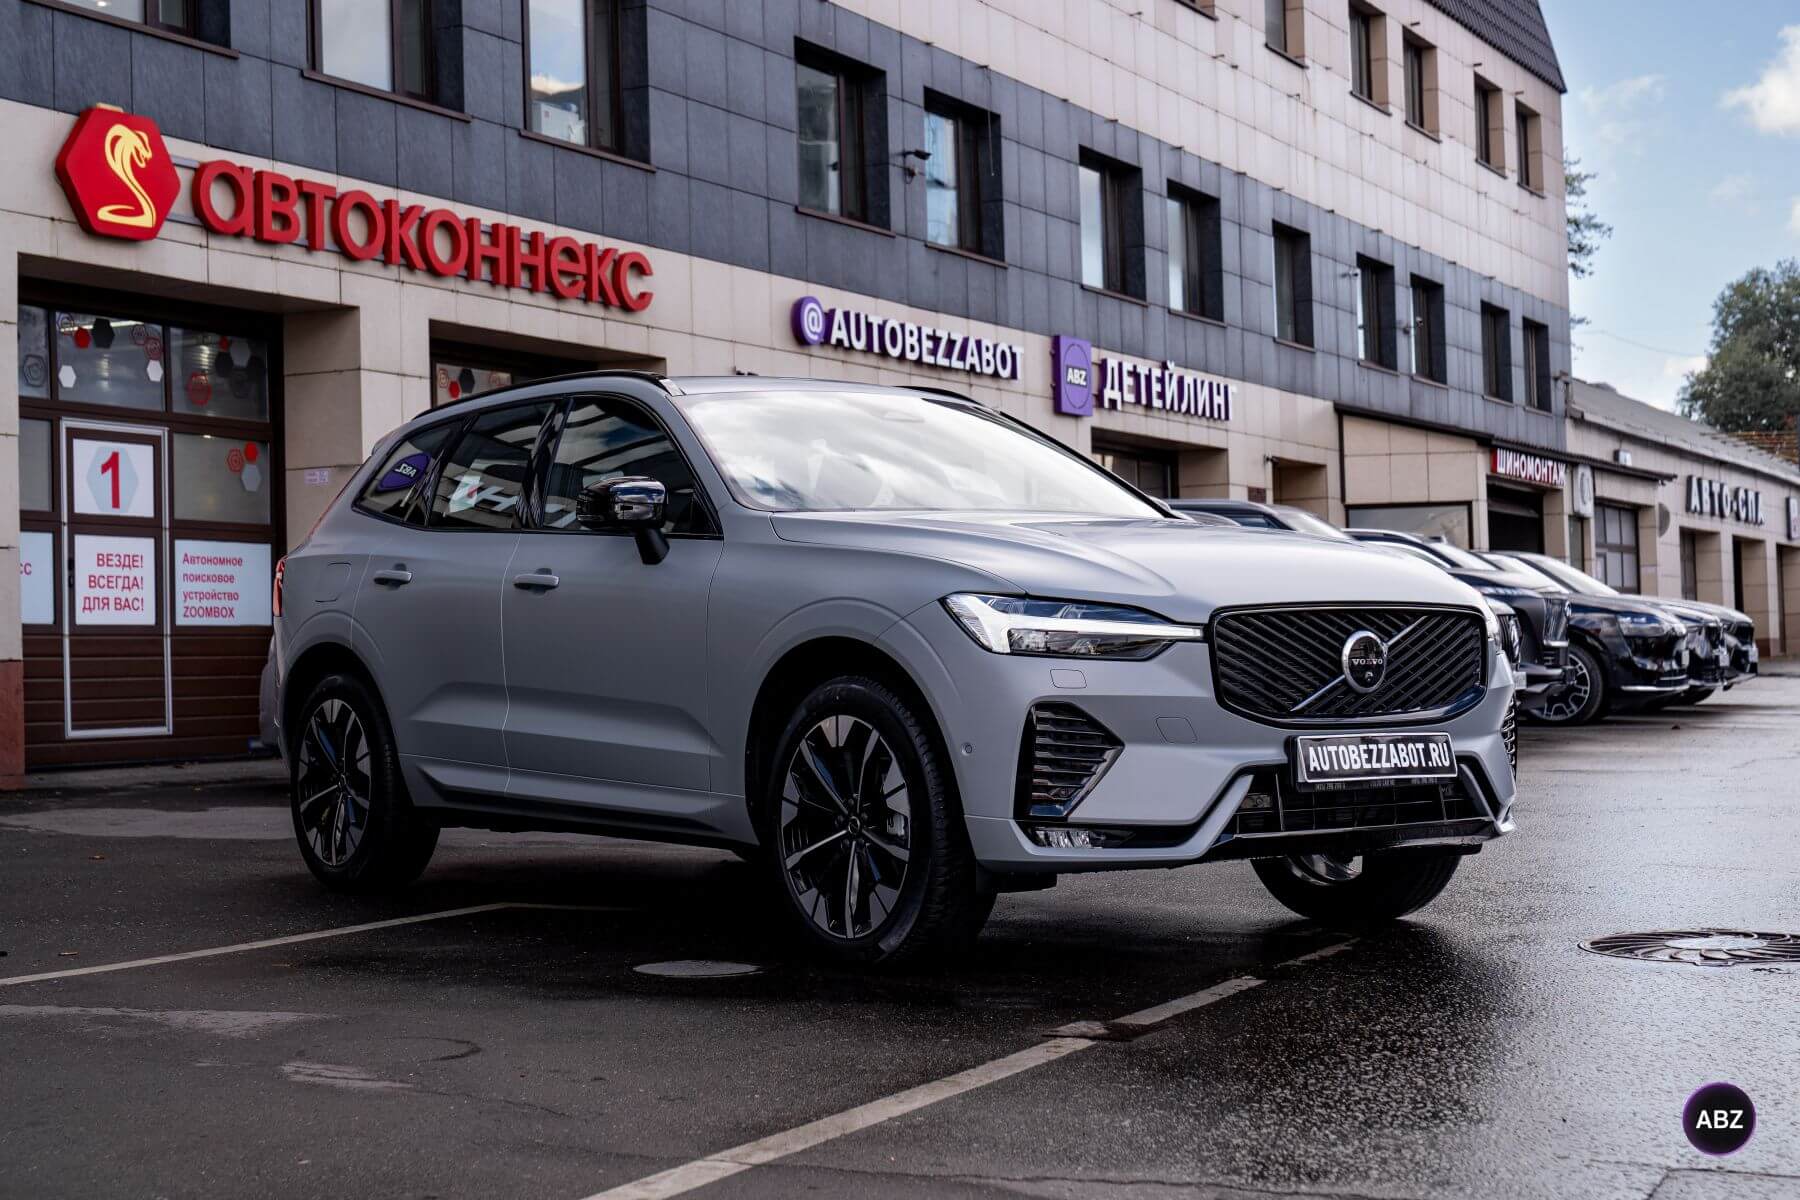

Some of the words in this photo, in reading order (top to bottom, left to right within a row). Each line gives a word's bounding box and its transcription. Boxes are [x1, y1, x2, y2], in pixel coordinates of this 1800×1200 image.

[830, 308, 1025, 382] AUTOBEZZABOT
[1066, 367, 1088, 386] ABZ
[1103, 358, 1238, 421] ДЕТЕЙЛИНГ
[1496, 447, 1567, 487] ШИНОМОНТАЖ
[100, 451, 121, 509] 1
[96, 553, 144, 570] ВЕЗДЕ!
[182, 552, 244, 567] Автономное
[88, 574, 144, 592] ВСЕГДА!
[182, 573, 236, 584] поисковое
[82, 596, 110, 613] ДЛЯ
[114, 596, 145, 612] ВАС!
[182, 588, 240, 603] устройство
[183, 605, 236, 619] ZOOMBOX
[1308, 742, 1451, 773] AUTOBEZZABOT.RU
